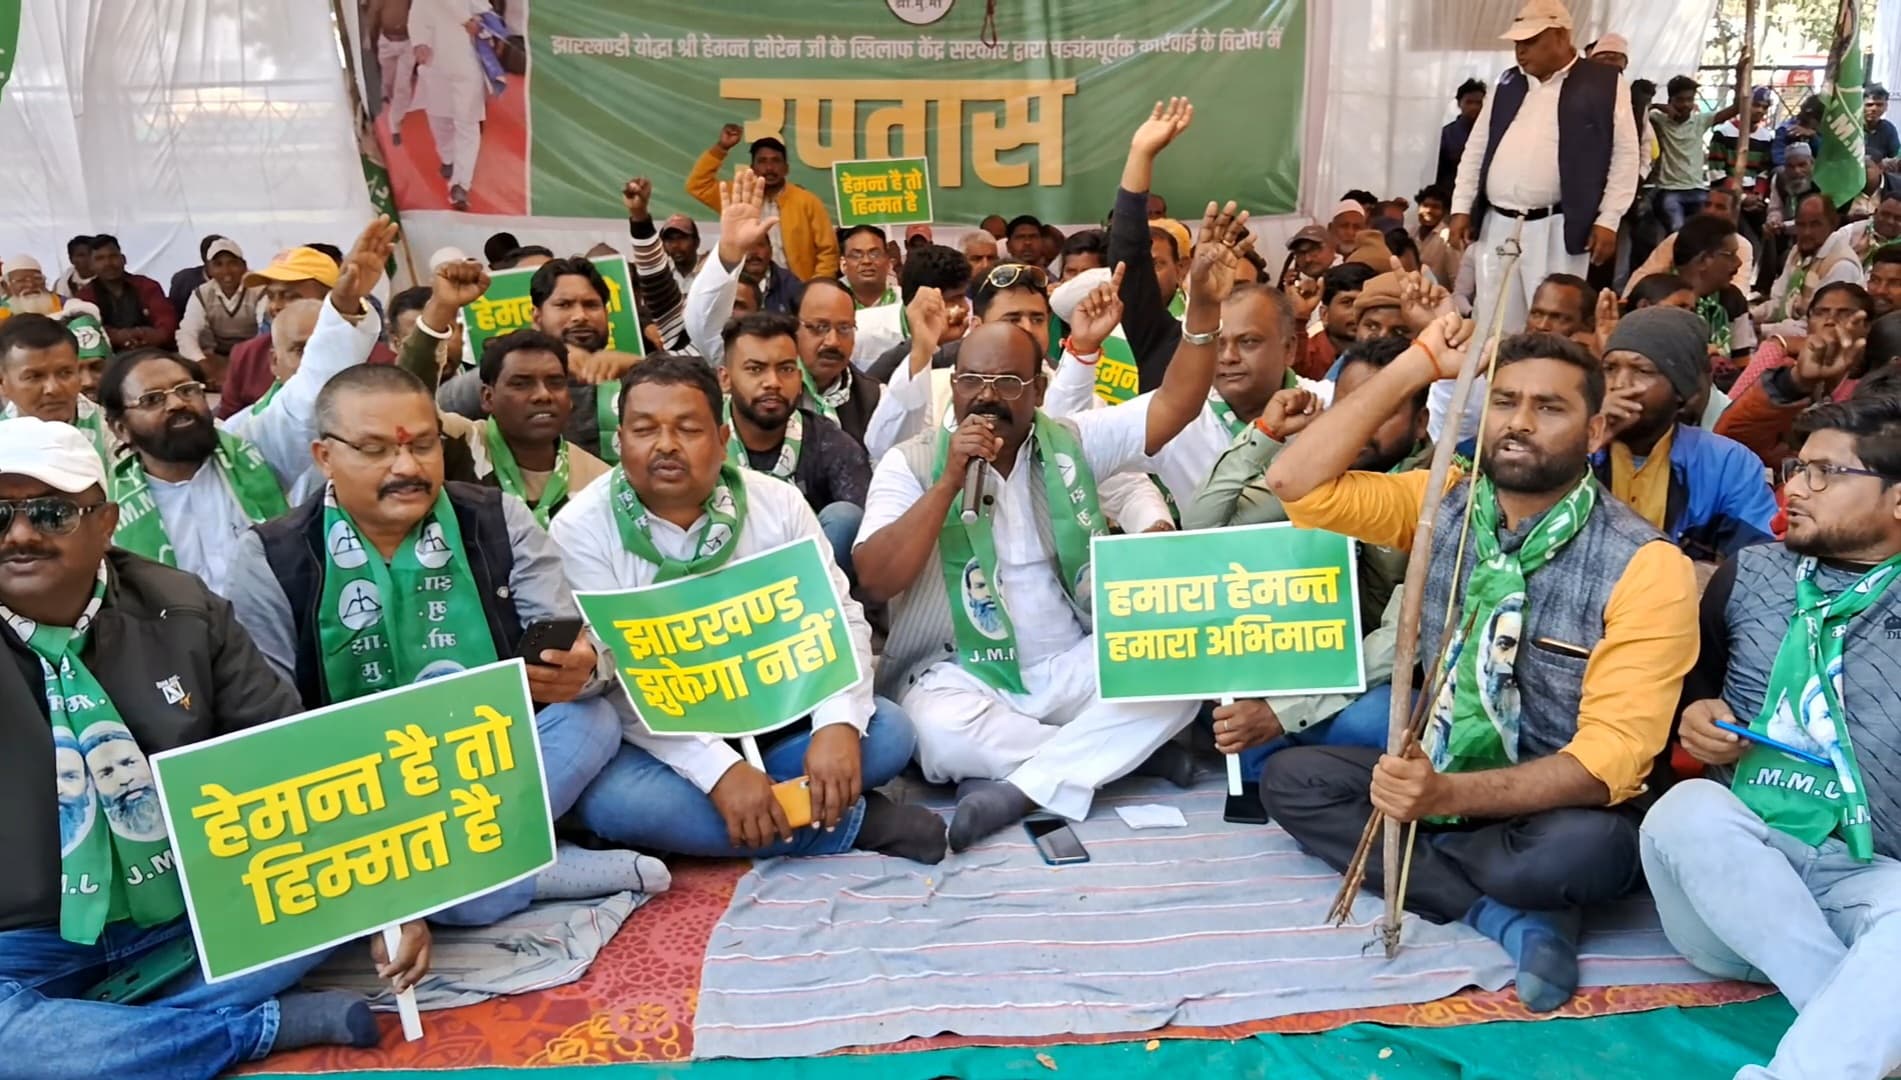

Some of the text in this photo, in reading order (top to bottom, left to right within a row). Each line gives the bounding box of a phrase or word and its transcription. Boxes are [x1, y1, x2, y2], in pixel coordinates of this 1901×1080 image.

[550, 32, 630, 57] झारखण्डी
[633, 33, 673, 59] योद्धा
[678, 33, 698, 58] श्री
[701, 33, 750, 58] हेमन्त
[752, 34, 802, 59] सोरेन
[805, 34, 826, 58] जी
[829, 35, 846, 58] के
[850, 36, 914, 59] खिलाफ
[917, 35, 946, 60] केंद्र
[950, 39, 1009, 59] सरकार
[1012, 40, 1047, 62] द्वारा
[1199, 28, 1217, 53] के
[1219, 28, 1267, 53] विरोध
[1267, 27, 1285, 49] में
[841, 168, 922, 194] हेमन्त है तो
[850, 190, 918, 216] हिम्मत है
[1104, 561, 1341, 617] हमारा हेमन्त
[613, 575, 804, 660] झारखण्ड
[1105, 614, 1347, 662] हमारा अभिमान
[626, 607, 836, 717] झुकेगा नहीं
[192, 704, 515, 858] हेमन्त है तो
[241, 783, 504, 926] हिम्मत है
